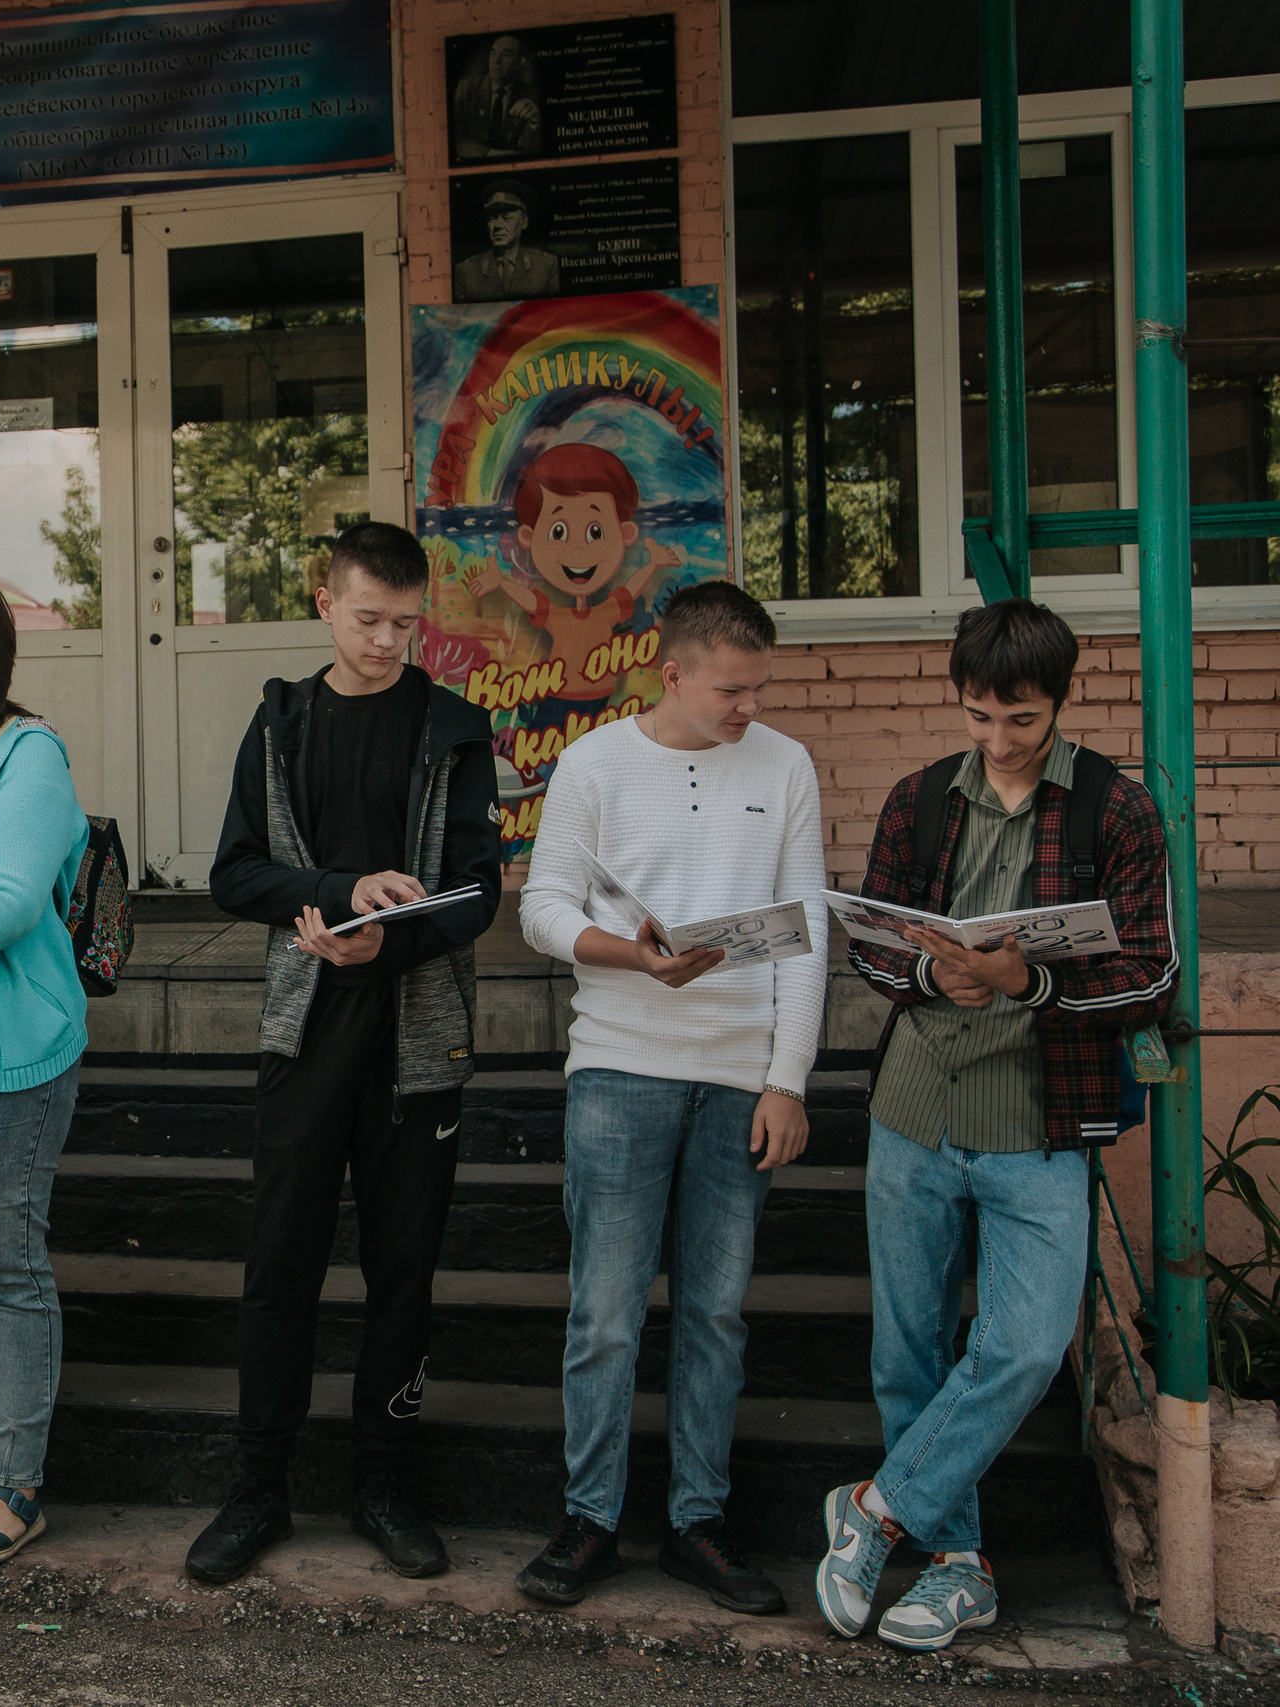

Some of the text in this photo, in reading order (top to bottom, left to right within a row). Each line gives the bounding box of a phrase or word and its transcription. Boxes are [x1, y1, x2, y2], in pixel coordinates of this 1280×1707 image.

[158, 11, 277, 40] бюджетное
[183, 41, 312, 70] учреждение
[110, 80, 222, 110] городского
[229, 74, 302, 97] округа
[4, 113, 227, 149] общеобразовательная
[235, 105, 302, 127] школа
[308, 97, 371, 120] №14»
[556, 120, 649, 137] Иван Алексеевич
[568, 106, 634, 122] МЕДВЕДЕВ
[18, 141, 247, 181] (МБОУ «СОШ №14»)
[597, 238, 641, 251] БУКИН
[560, 251, 679, 268] Василий Арсентьевич
[423, 350, 714, 511] УРА КАНИКУЛЫ!
